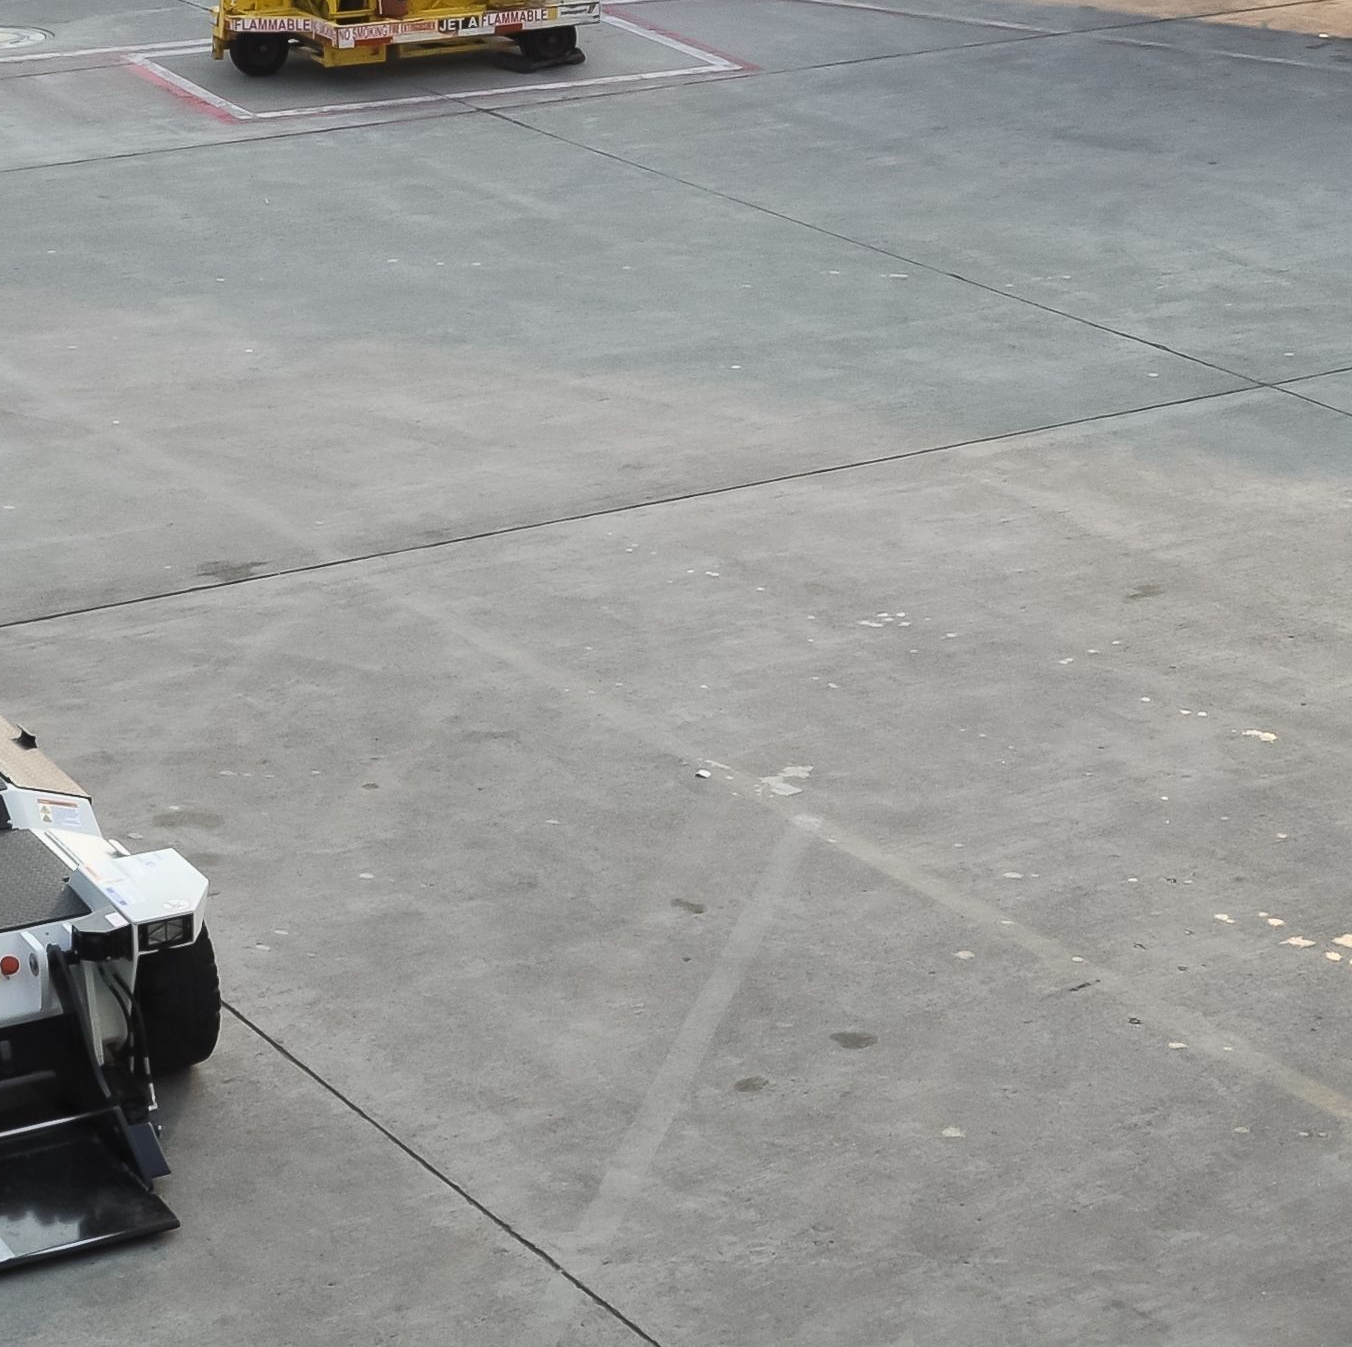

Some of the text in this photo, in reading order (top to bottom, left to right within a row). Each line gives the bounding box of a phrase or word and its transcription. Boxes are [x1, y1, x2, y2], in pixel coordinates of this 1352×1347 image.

[234, 18, 310, 32] FLAMMABLE
[439, 17, 465, 32] JET
[468, 15, 478, 28] A
[481, 8, 548, 26] FLAMMABLE
